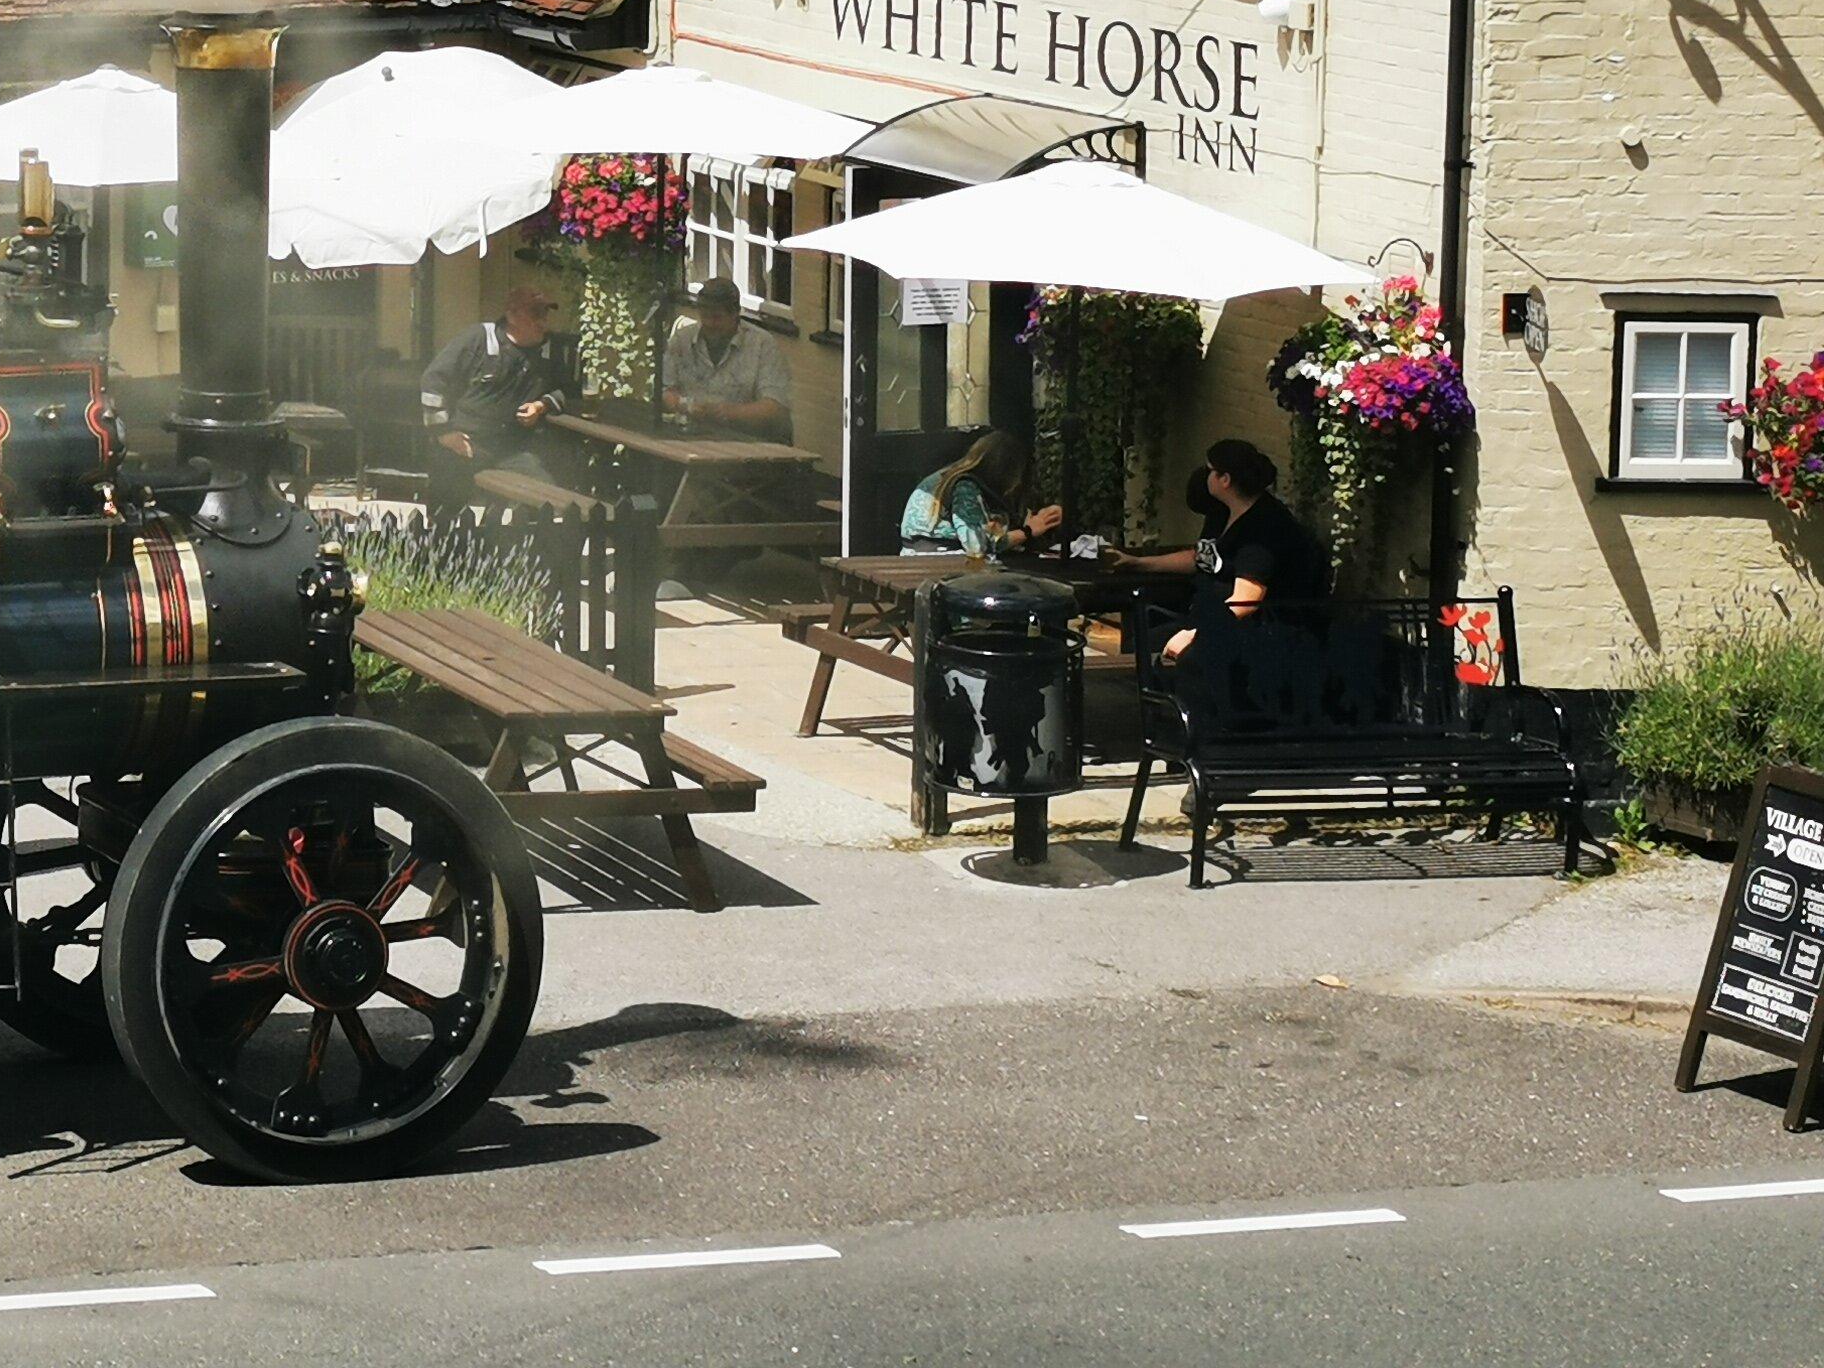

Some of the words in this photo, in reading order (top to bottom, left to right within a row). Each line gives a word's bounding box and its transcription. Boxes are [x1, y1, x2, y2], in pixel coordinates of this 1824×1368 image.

[1045, 9, 1260, 121] HORSE
[1176, 113, 1257, 176] INN
[304, 267, 360, 283] SNACKS
[1524, 321, 1545, 351] OPEN
[1766, 806, 1824, 841] VILLAGE
[1793, 843, 1824, 864] OPEN
